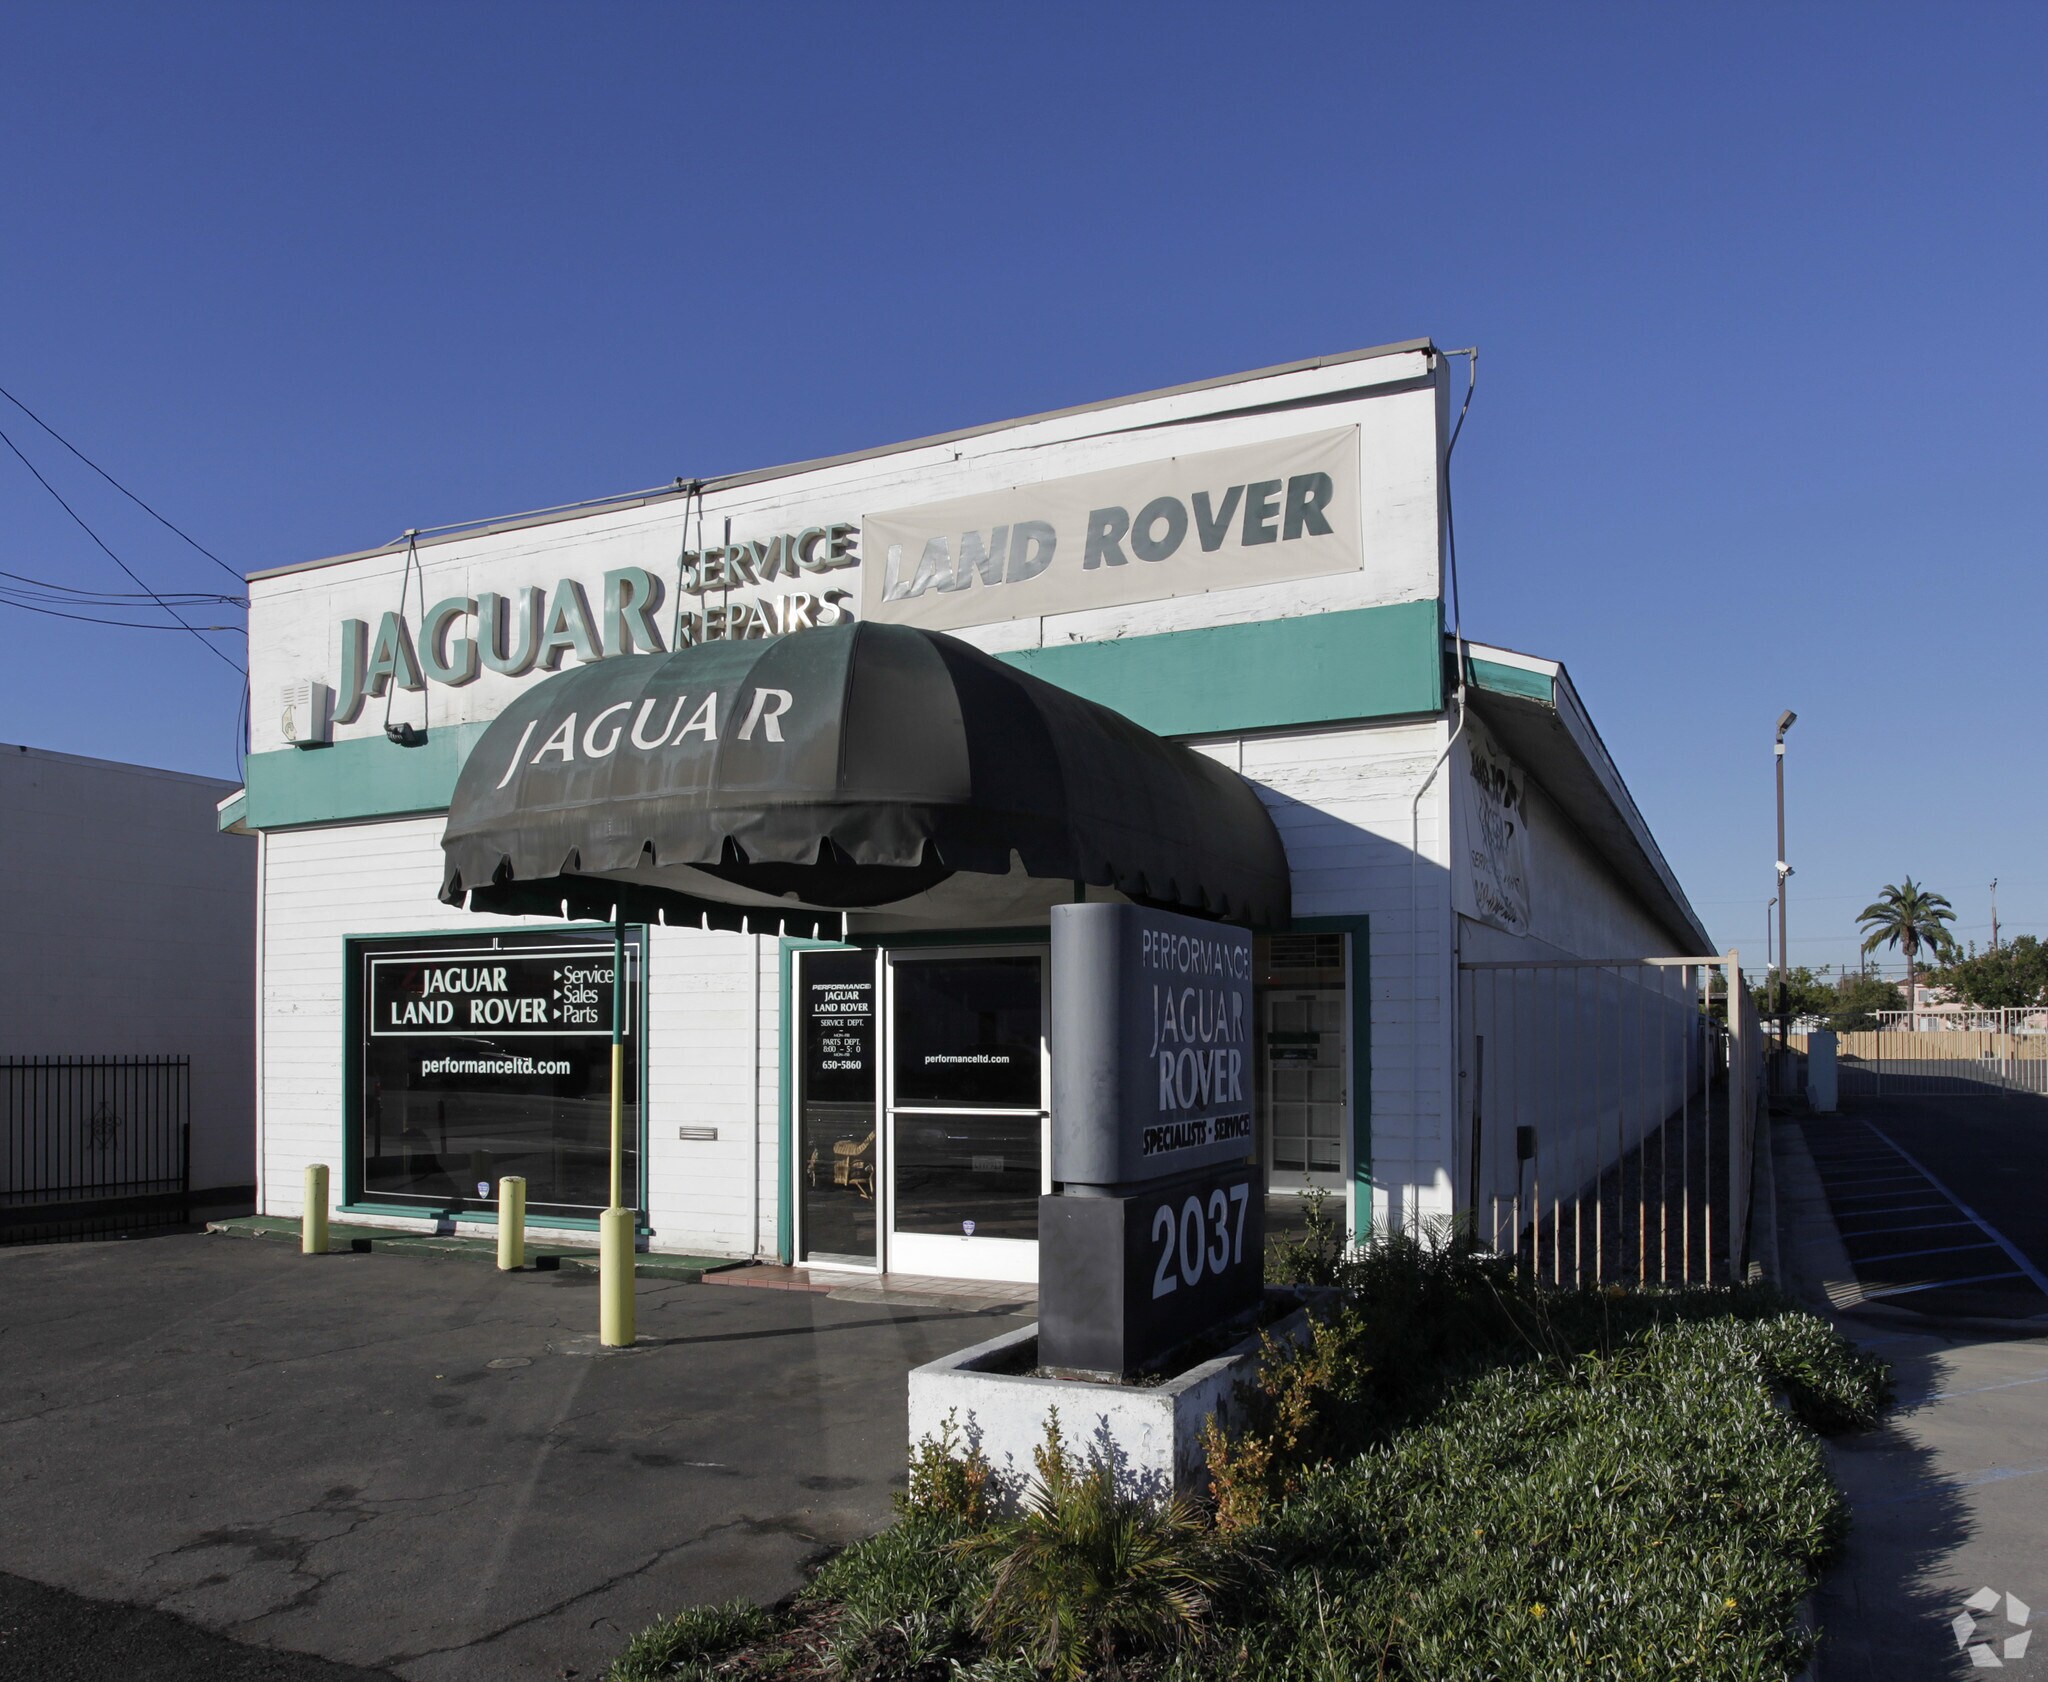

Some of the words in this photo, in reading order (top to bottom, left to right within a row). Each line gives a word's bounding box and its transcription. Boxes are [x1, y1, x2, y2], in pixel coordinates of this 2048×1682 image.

[882, 519, 1057, 603] LAND
[1083, 471, 1334, 570] ROVER
[676, 522, 857, 594] SERVICE
[674, 586, 845, 650] REPAIRS
[330, 566, 667, 725] JAGUAR
[496, 687, 794, 790] JAGUAR
[1143, 928, 1249, 980] PERFORMANCE
[422, 967, 508, 998] JAGUAR
[563, 965, 615, 984] Service
[563, 984, 598, 1004] Sales
[812, 983, 872, 991] PERFORMANCE
[824, 991, 859, 1002] JAGUAR
[391, 1000, 454, 1025] LAND
[470, 998, 548, 1024] ROVER
[563, 1004, 598, 1023] Parts
[814, 1003, 838, 1012] LAND
[840, 1003, 868, 1012] ROVER
[820, 1019, 844, 1027] SERVICE
[847, 1019, 864, 1027] DEPT.
[1150, 984, 1245, 1058] JAGUAR
[822, 1038, 841, 1046] PARTS
[844, 1038, 861, 1046] DEPT.
[422, 1056, 571, 1077] performanceltd.com
[822, 1060, 862, 1070] 650-5860
[925, 1054, 1010, 1065] performanceltd.com
[1158, 1048, 1243, 1112] ROVER
[1143, 1119, 1208, 1156] SPECIALISTS
[1214, 1112, 1250, 1139] SERVICE
[1152, 1183, 1250, 1300] 2037
